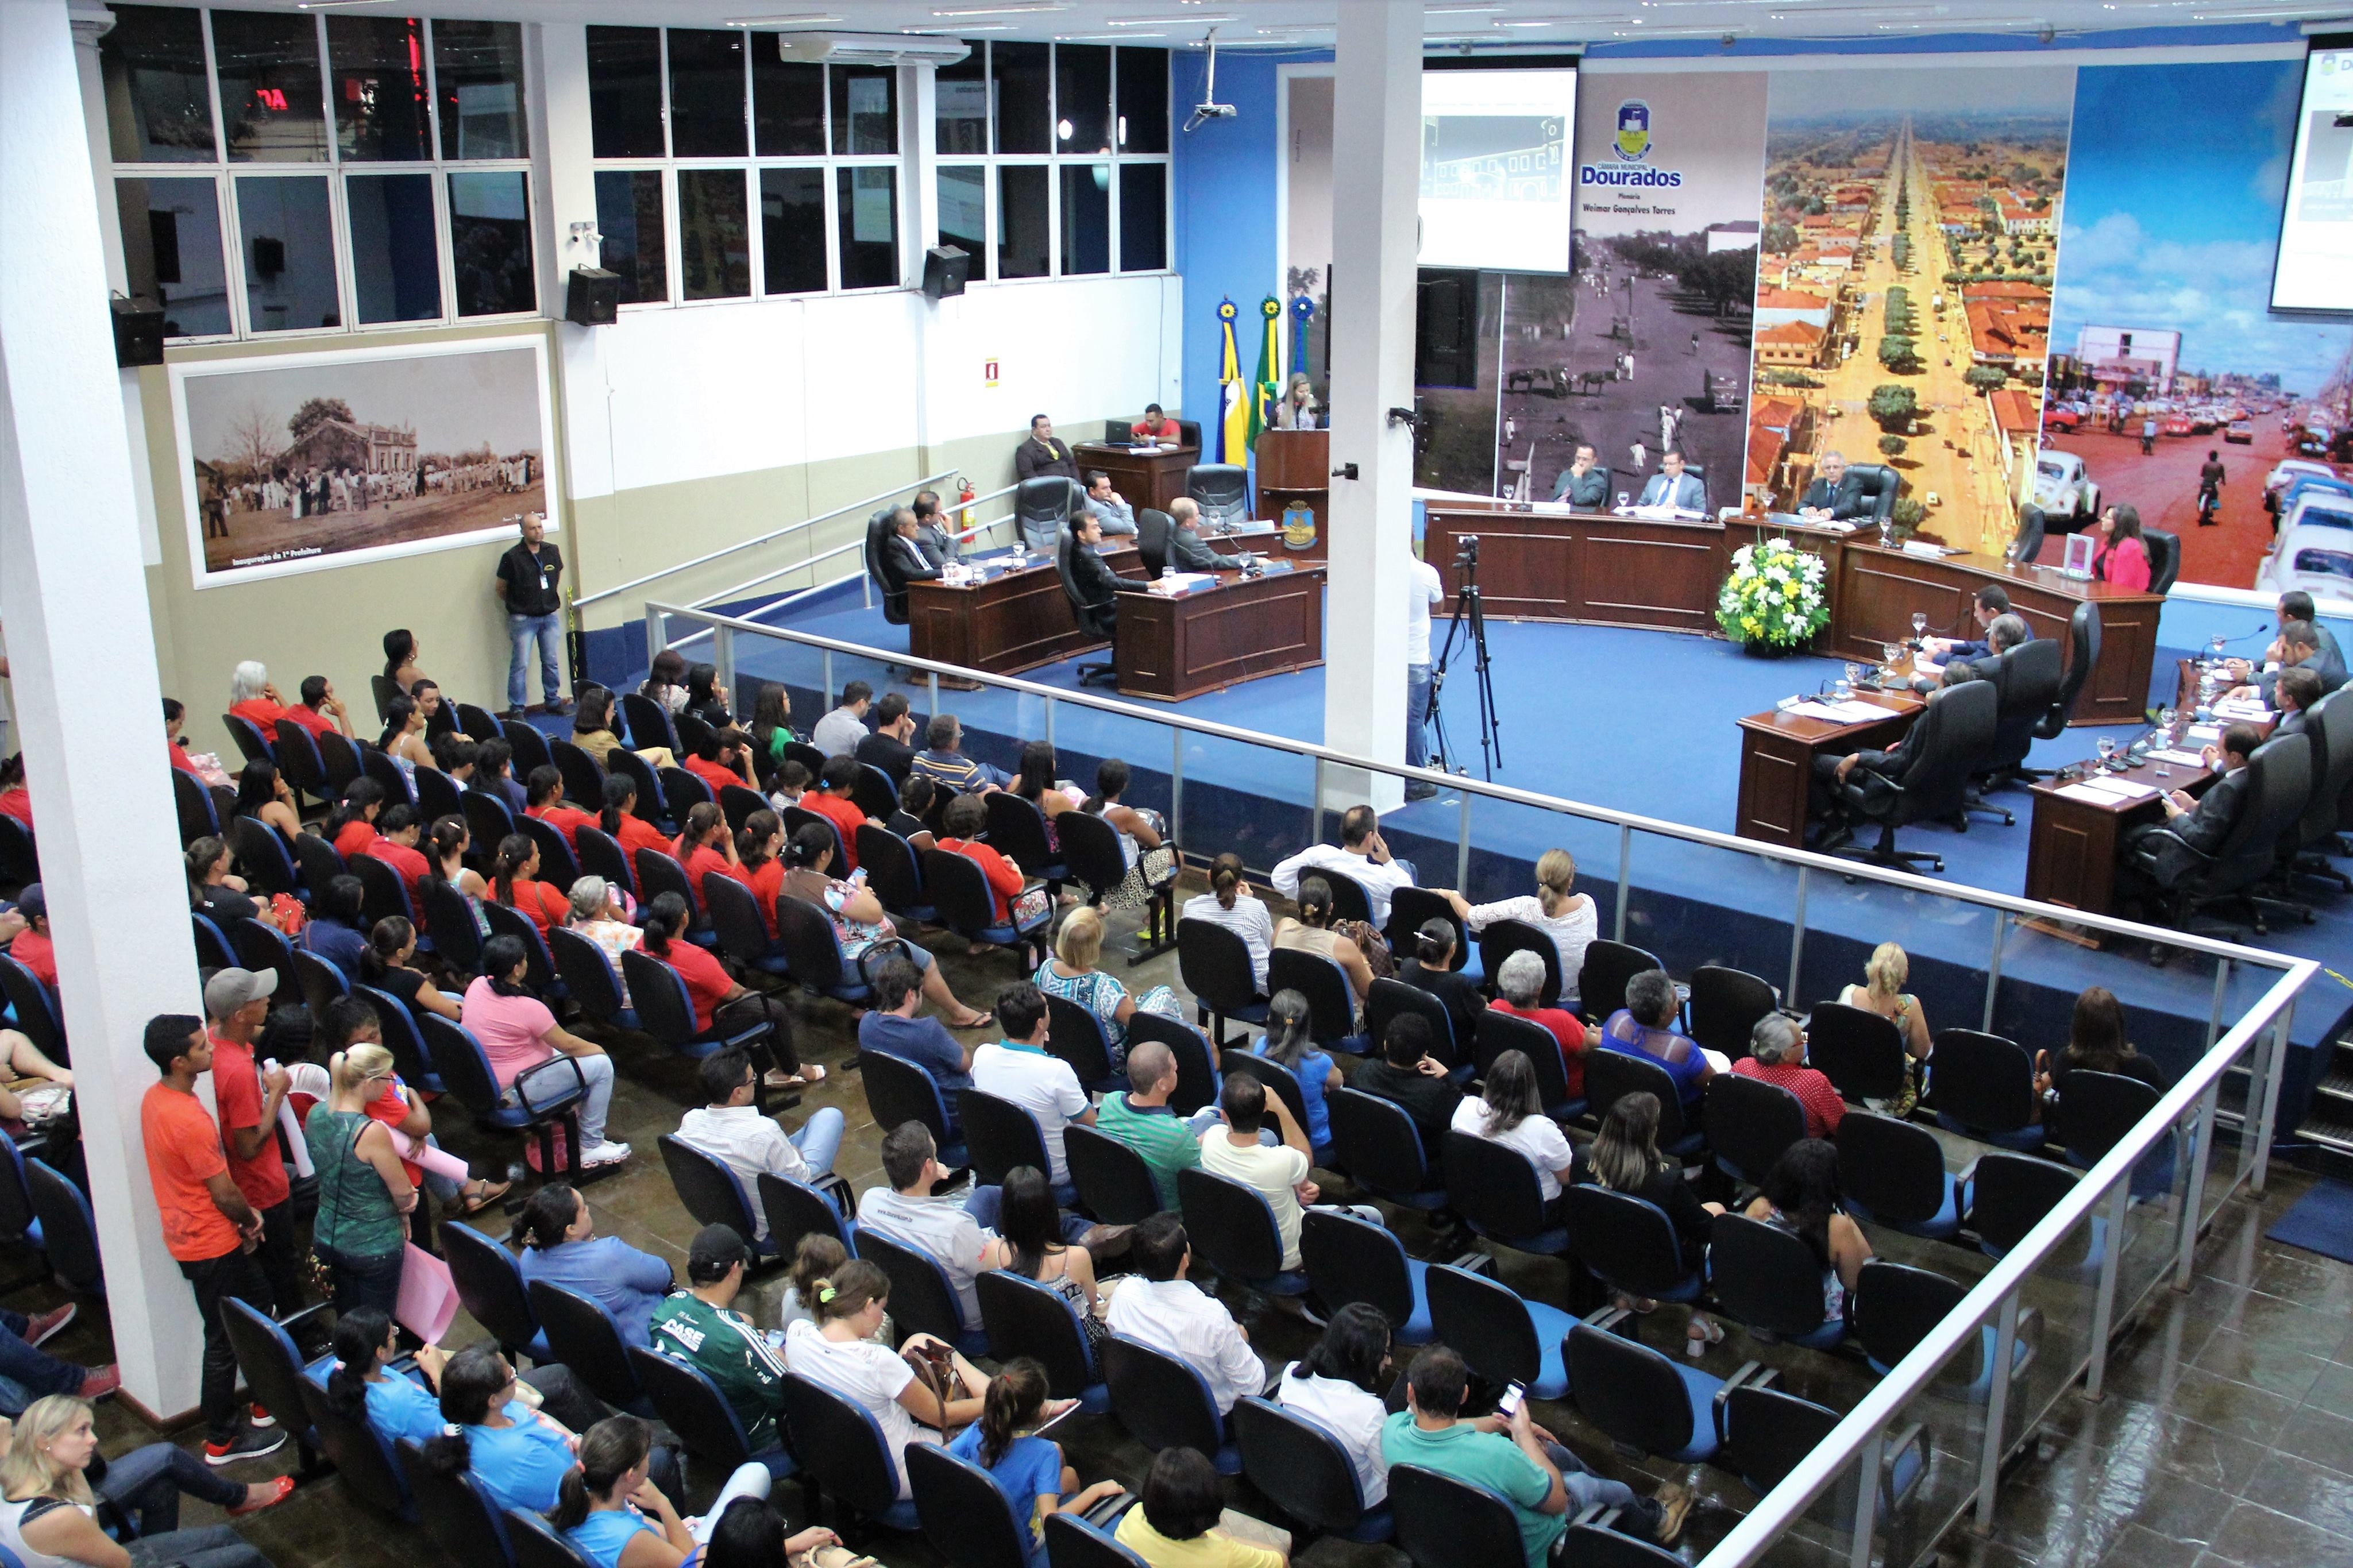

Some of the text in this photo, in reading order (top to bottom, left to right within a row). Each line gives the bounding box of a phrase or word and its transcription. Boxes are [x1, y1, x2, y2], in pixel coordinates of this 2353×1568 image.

[1581, 167, 1681, 187] Dourados
[1583, 203, 1676, 215] Weimar Gonçalves Torres
[273, 551, 281, 560] da
[291, 546, 322, 557] Prefeitura
[665, 1318, 707, 1346] CASE
